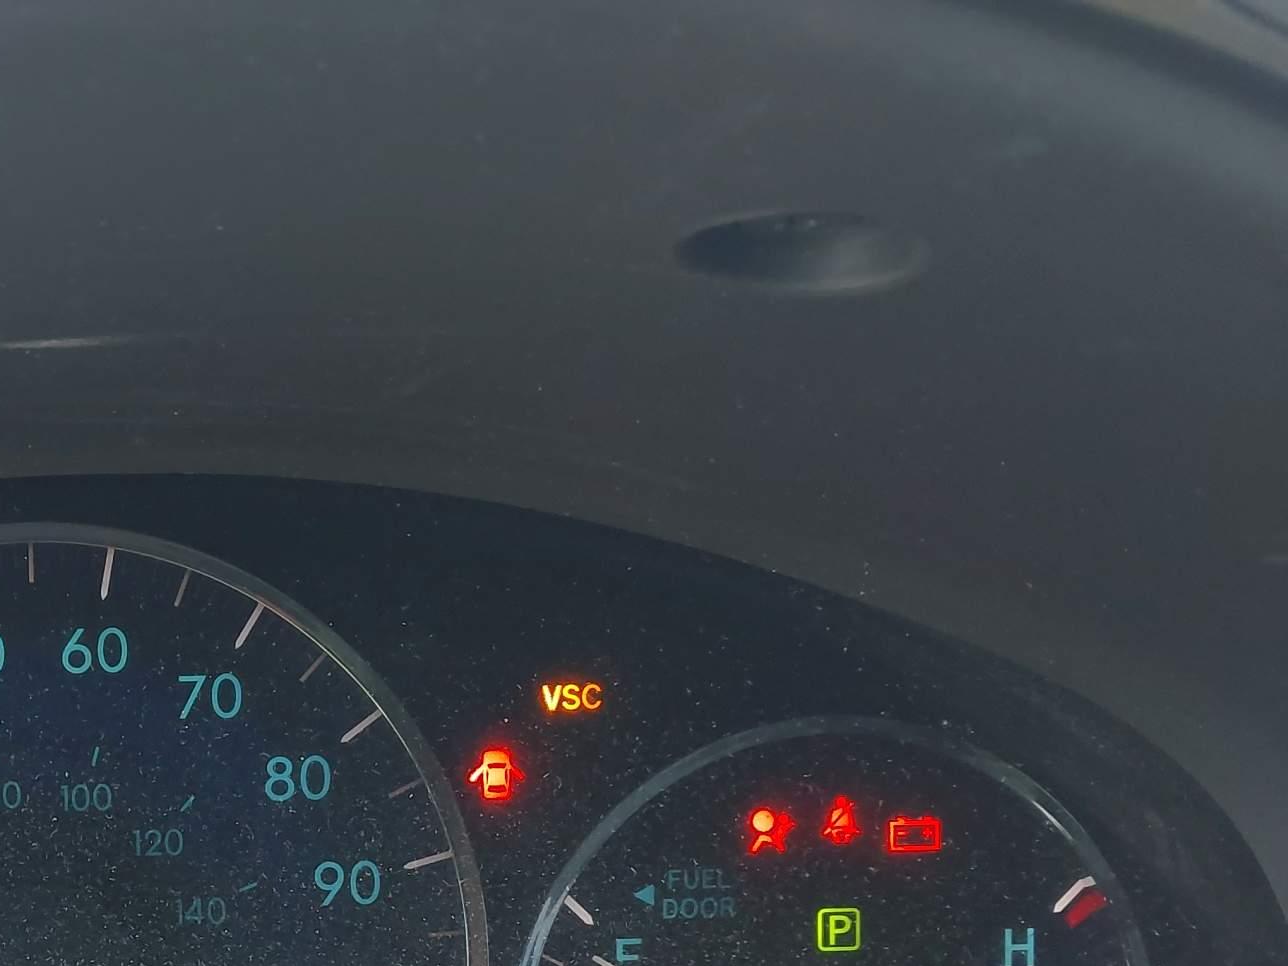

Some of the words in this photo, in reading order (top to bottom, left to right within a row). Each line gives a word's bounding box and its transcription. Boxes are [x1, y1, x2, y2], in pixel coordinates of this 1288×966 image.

[62, 628, 128, 674] 60
[178, 675, 242, 719] 70
[542, 684, 603, 711] VSC
[265, 756, 330, 801] 80
[61, 784, 112, 812] 100
[135, 829, 183, 856] 120
[315, 861, 380, 906] 90
[667, 869, 732, 889] FUEL
[176, 898, 226, 925] 140
[663, 897, 736, 919] DOOR
[830, 915, 850, 946] P
[1005, 928, 1034, 966] H
